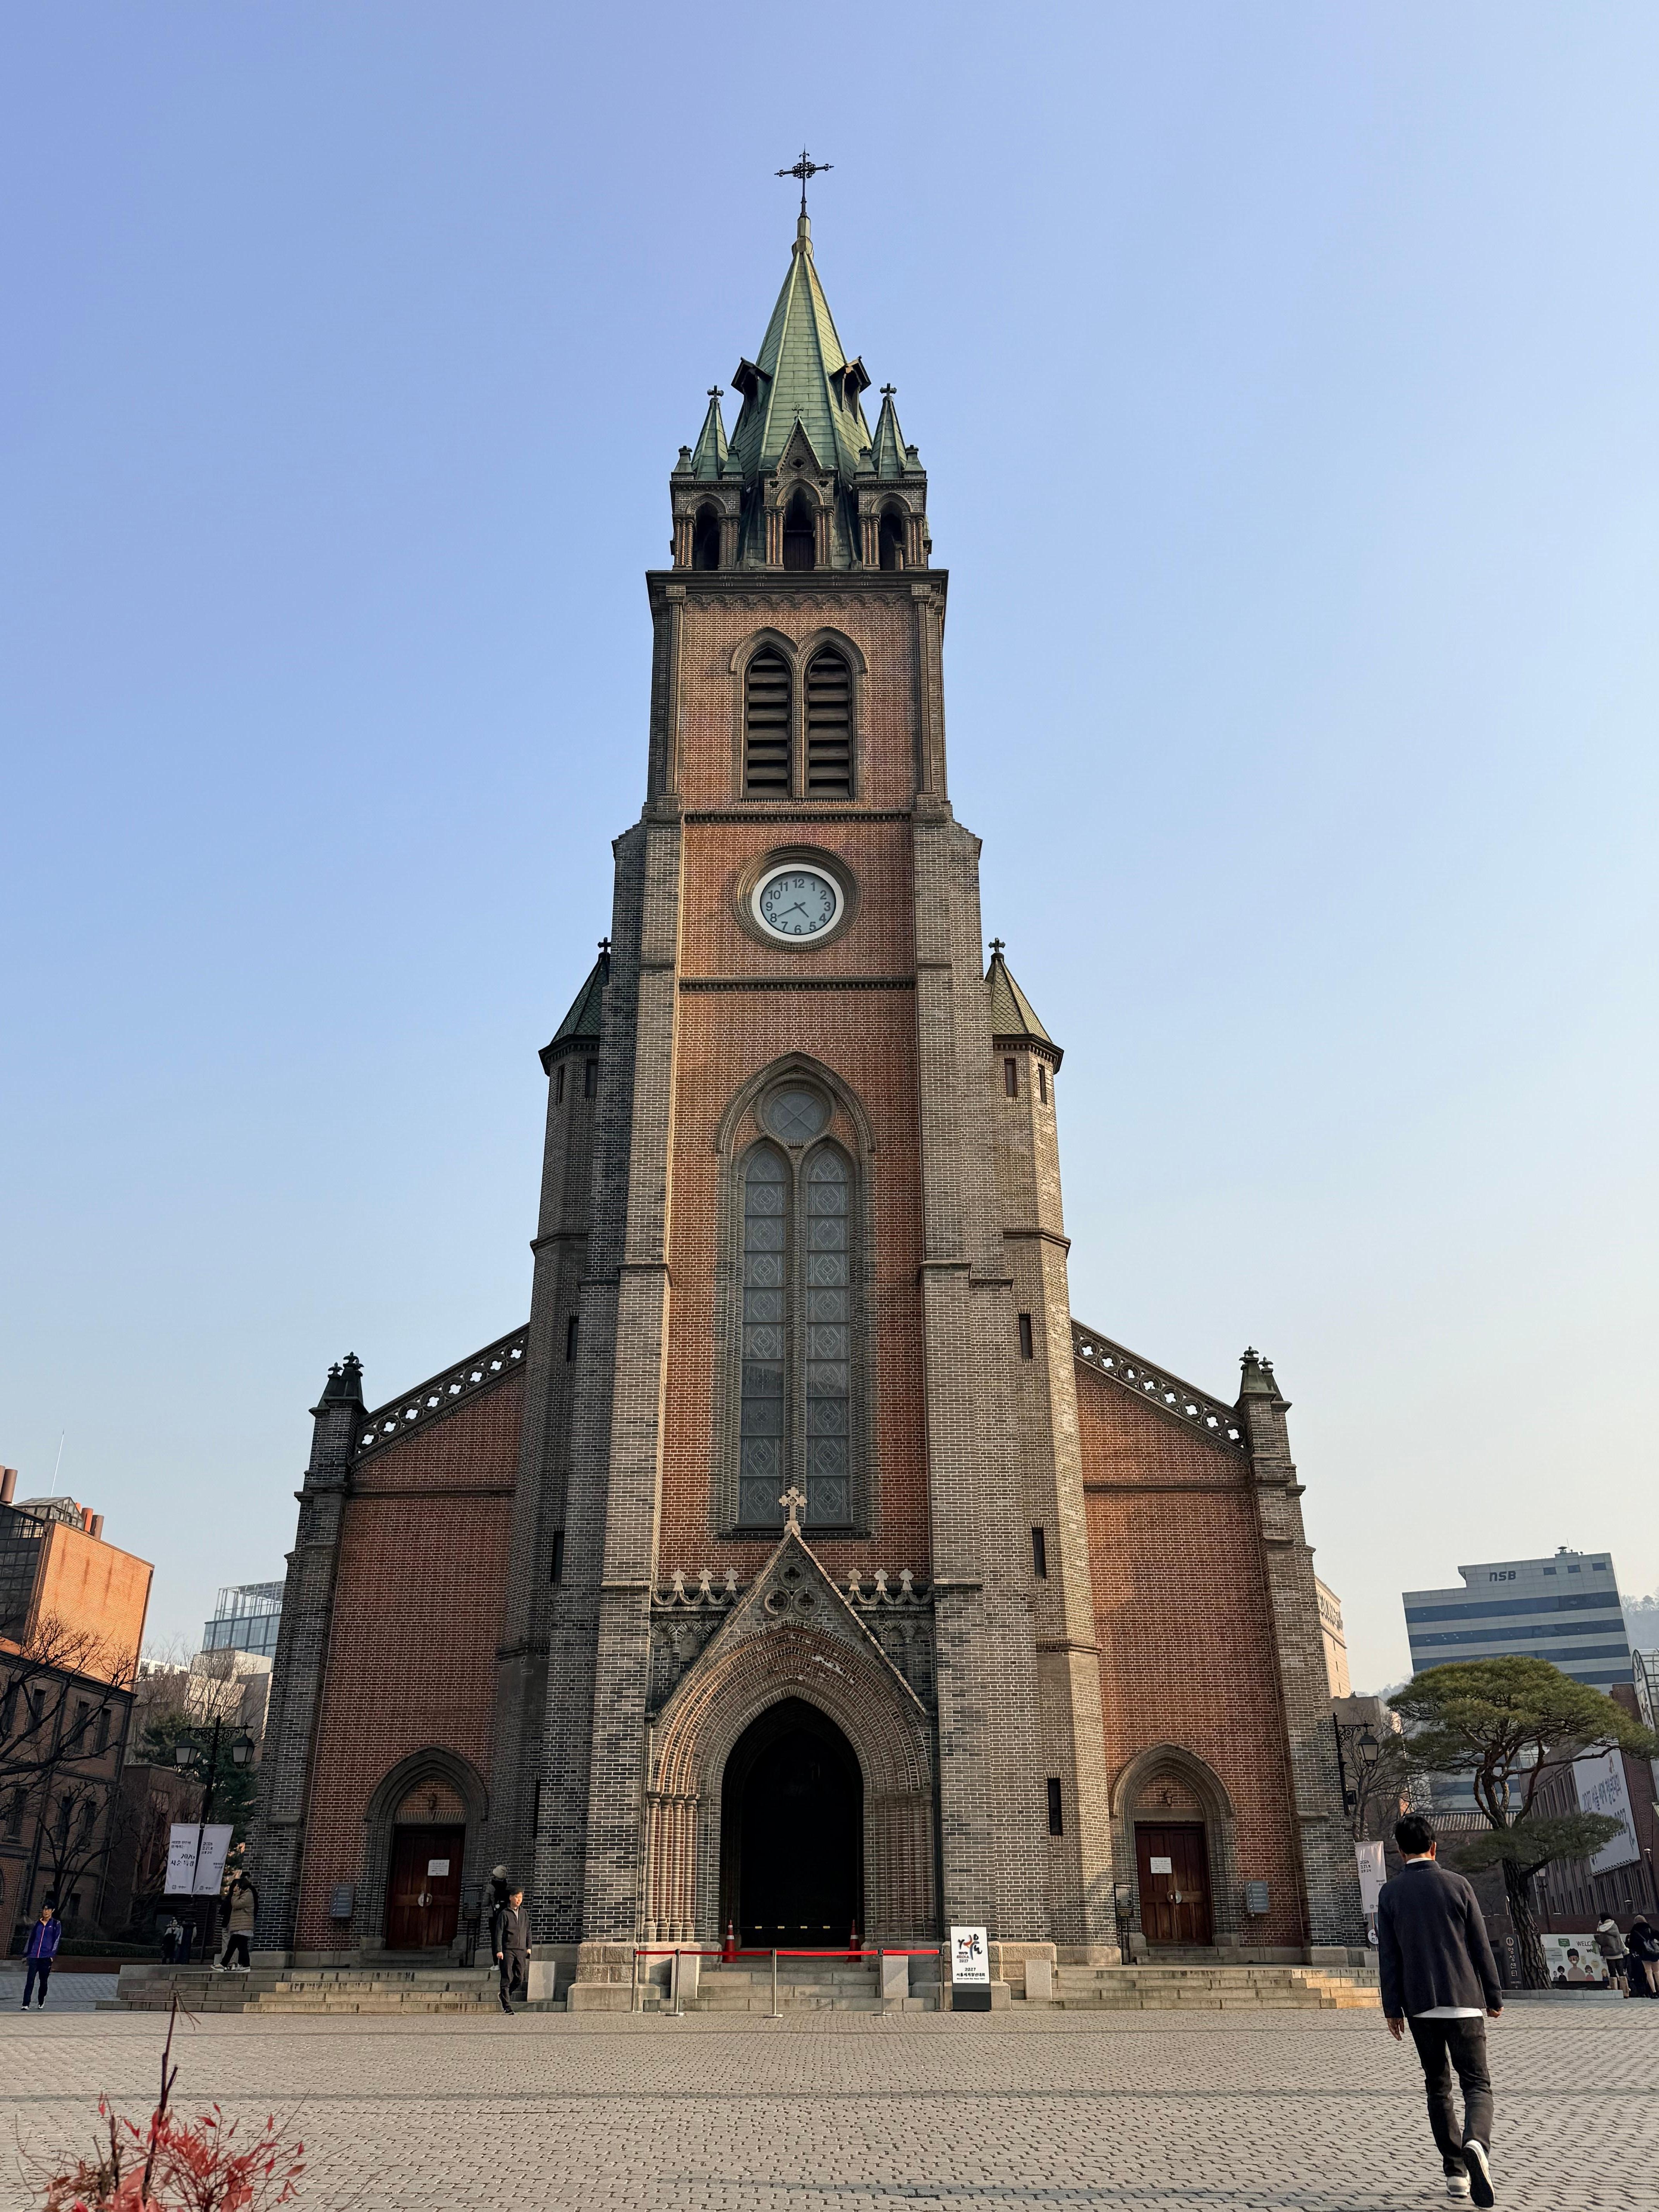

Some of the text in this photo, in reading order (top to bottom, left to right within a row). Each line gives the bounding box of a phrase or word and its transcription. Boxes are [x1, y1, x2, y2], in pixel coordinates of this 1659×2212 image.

[778, 881, 788, 891] 11
[792, 878, 804, 888] 12
[811, 881, 815, 891] 1
[768, 890, 781, 900] 10
[820, 890, 827, 900] 2
[766, 902, 773, 911] 9
[824, 902, 831, 911] 3
[770, 913, 777, 922] 8
[819, 913, 826, 923] 4
[781, 921, 788, 931] 7
[794, 925, 801, 934] 6
[809, 921, 816, 931] 5
[1508, 1947, 1517, 1977] 영성센터
